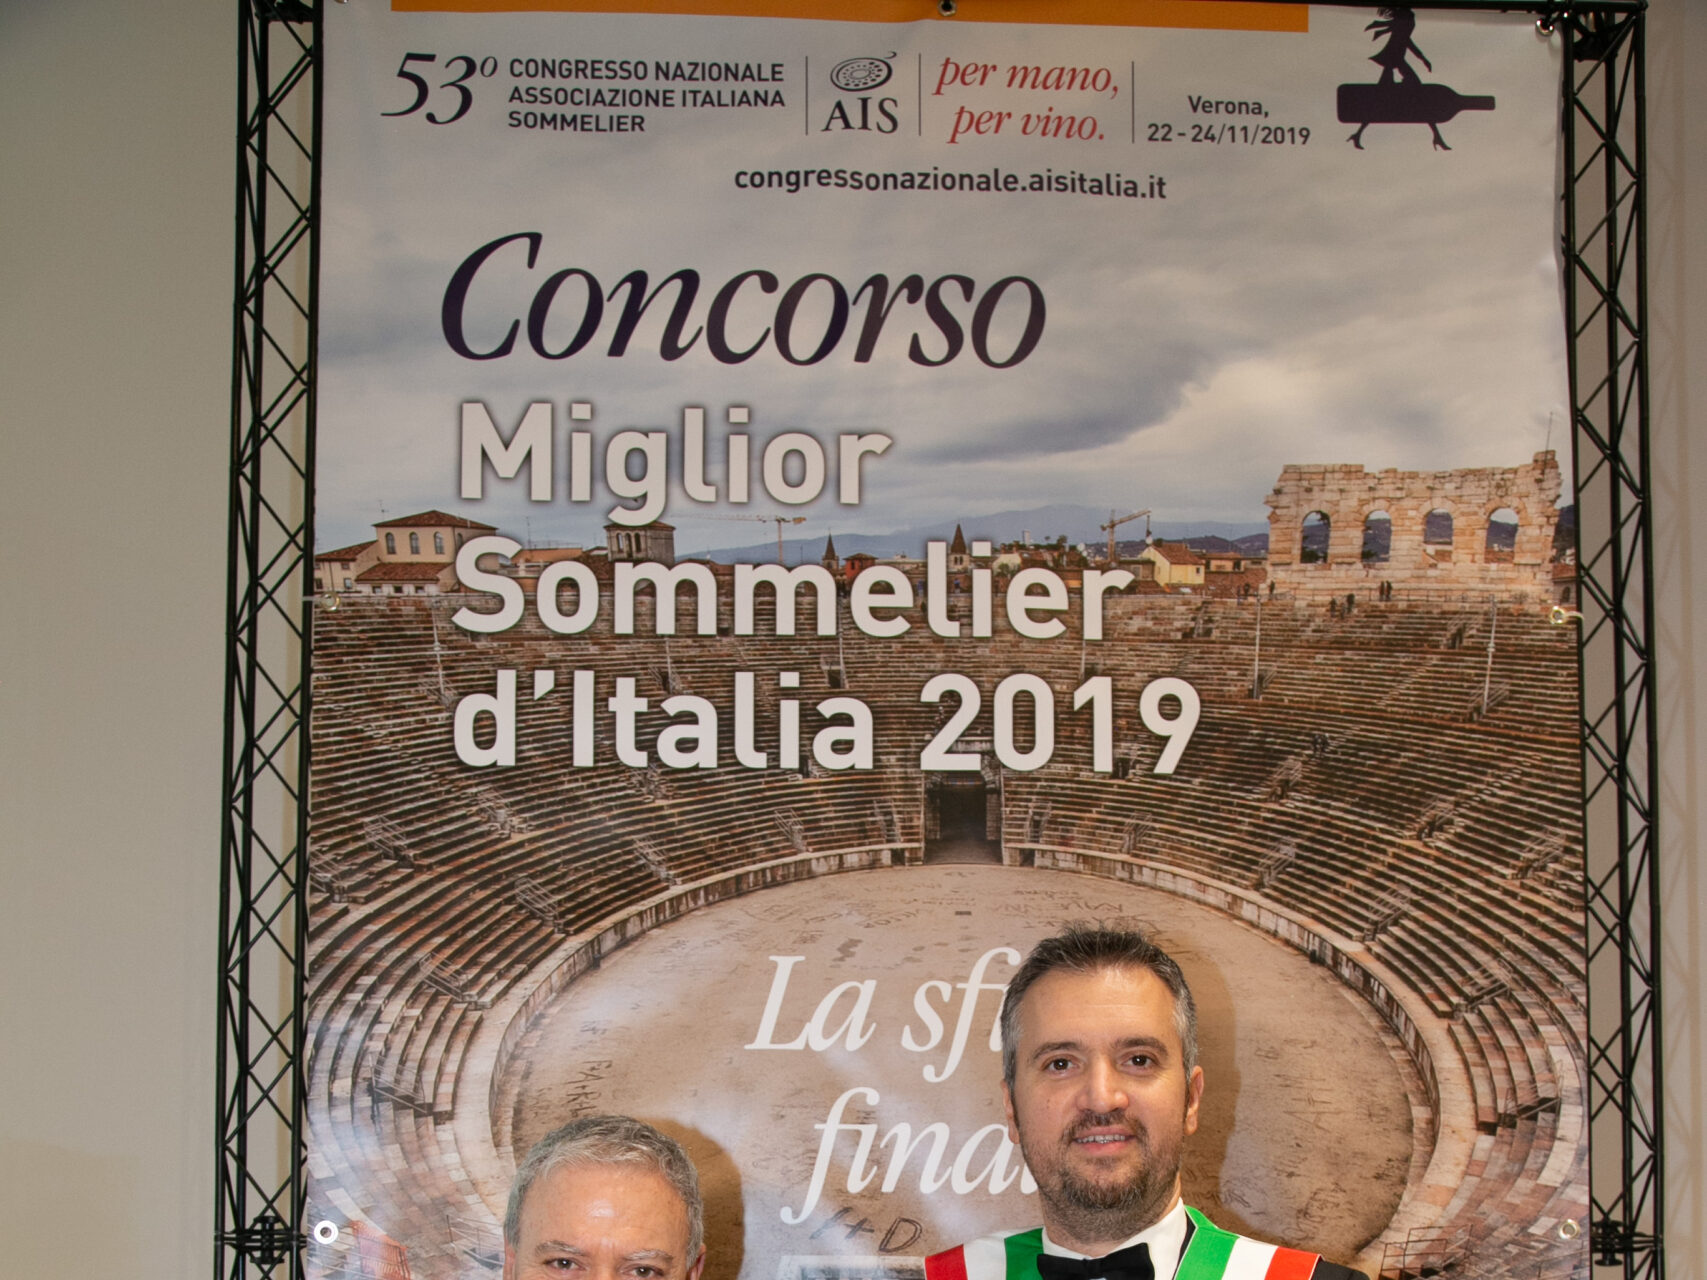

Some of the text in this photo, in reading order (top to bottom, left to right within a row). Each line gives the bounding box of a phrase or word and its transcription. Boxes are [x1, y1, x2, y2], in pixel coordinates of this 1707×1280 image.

[509, 57, 784, 83] CONGRESSO NAZIONALE
[931, 56, 1119, 98] per mano,
[509, 86, 786, 108] ASSOCIAZIONE ITALIANA
[821, 97, 899, 134] AIS
[1187, 95, 1270, 119] Verona,
[508, 111, 645, 132] SOMMELIER
[947, 105, 1105, 144] per vino.
[734, 166, 1167, 199] congressonazionale.aisitalia.it
[440, 231, 1047, 368] Concorso
[459, 401, 893, 526] Miglior
[450, 535, 1136, 642] Sommelier
[920, 672, 1202, 775] 2019
[744, 946, 1022, 1083] La sfi
[780, 1086, 1038, 1225] fina
